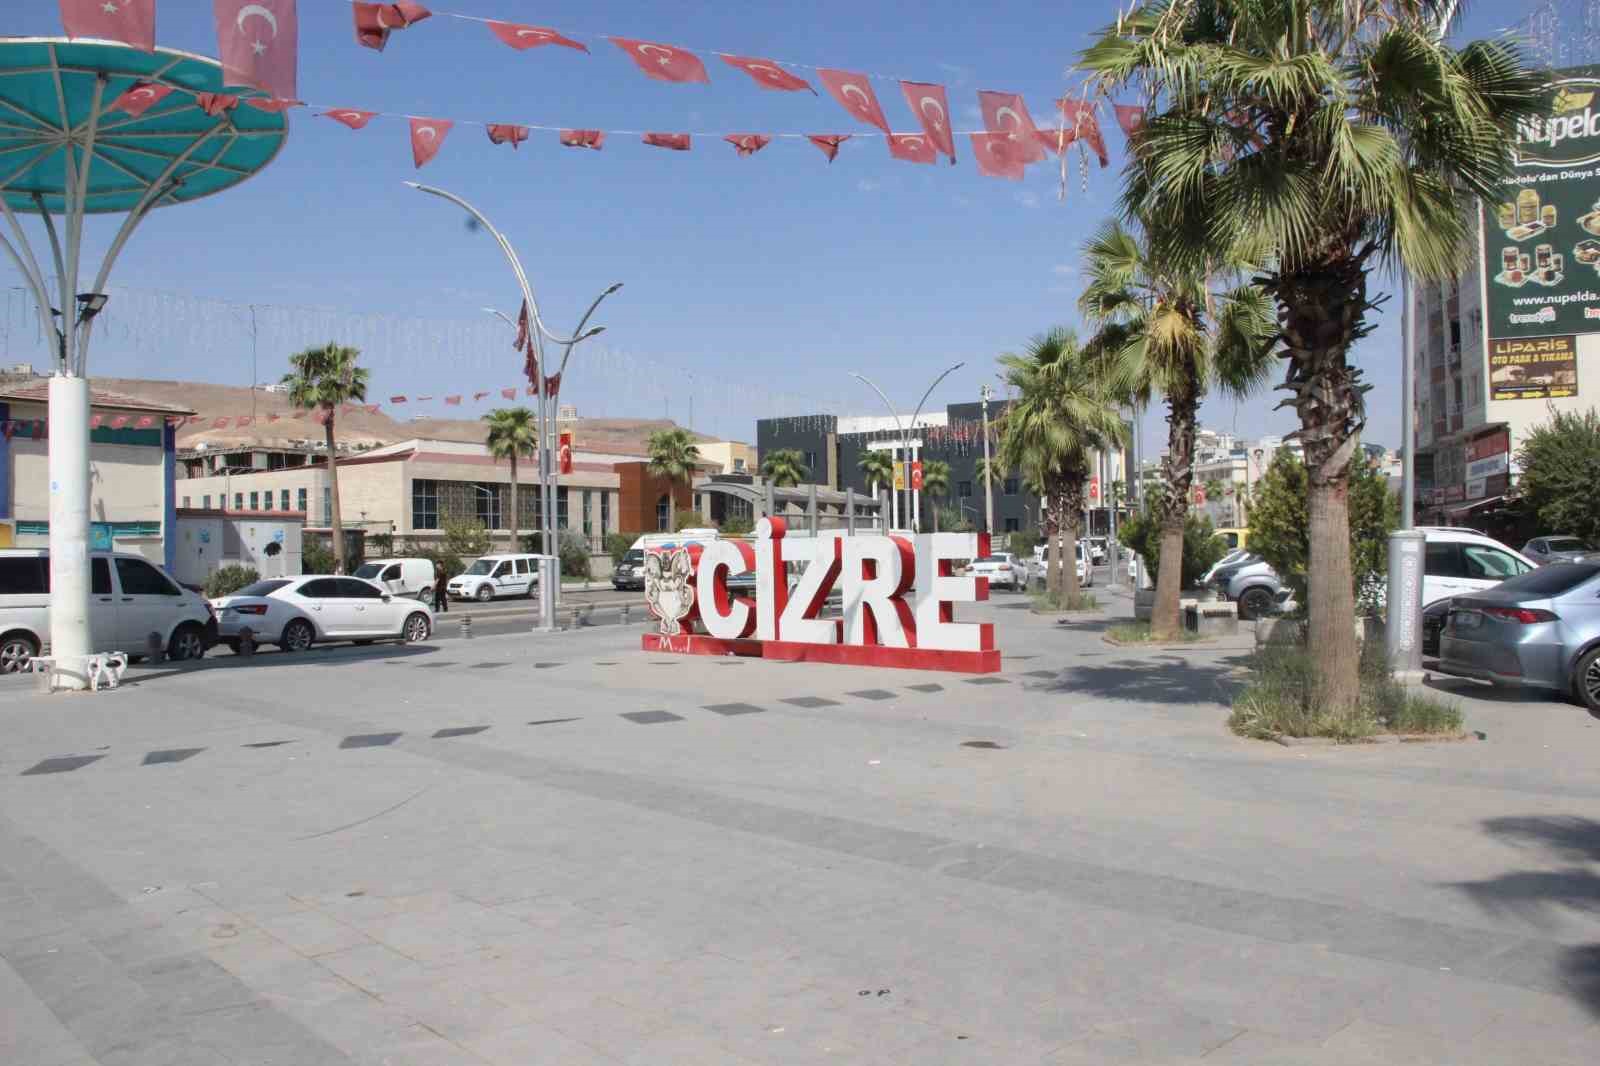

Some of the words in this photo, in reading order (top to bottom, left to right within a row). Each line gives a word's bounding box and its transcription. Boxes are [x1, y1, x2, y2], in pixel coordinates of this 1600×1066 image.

[1496, 172, 1557, 185] nadolu'dan
[1560, 169, 1593, 181] Dünya
[1491, 355, 1508, 365] OTO
[1509, 354, 1532, 365] PARK
[697, 516, 993, 651] CİZRE
